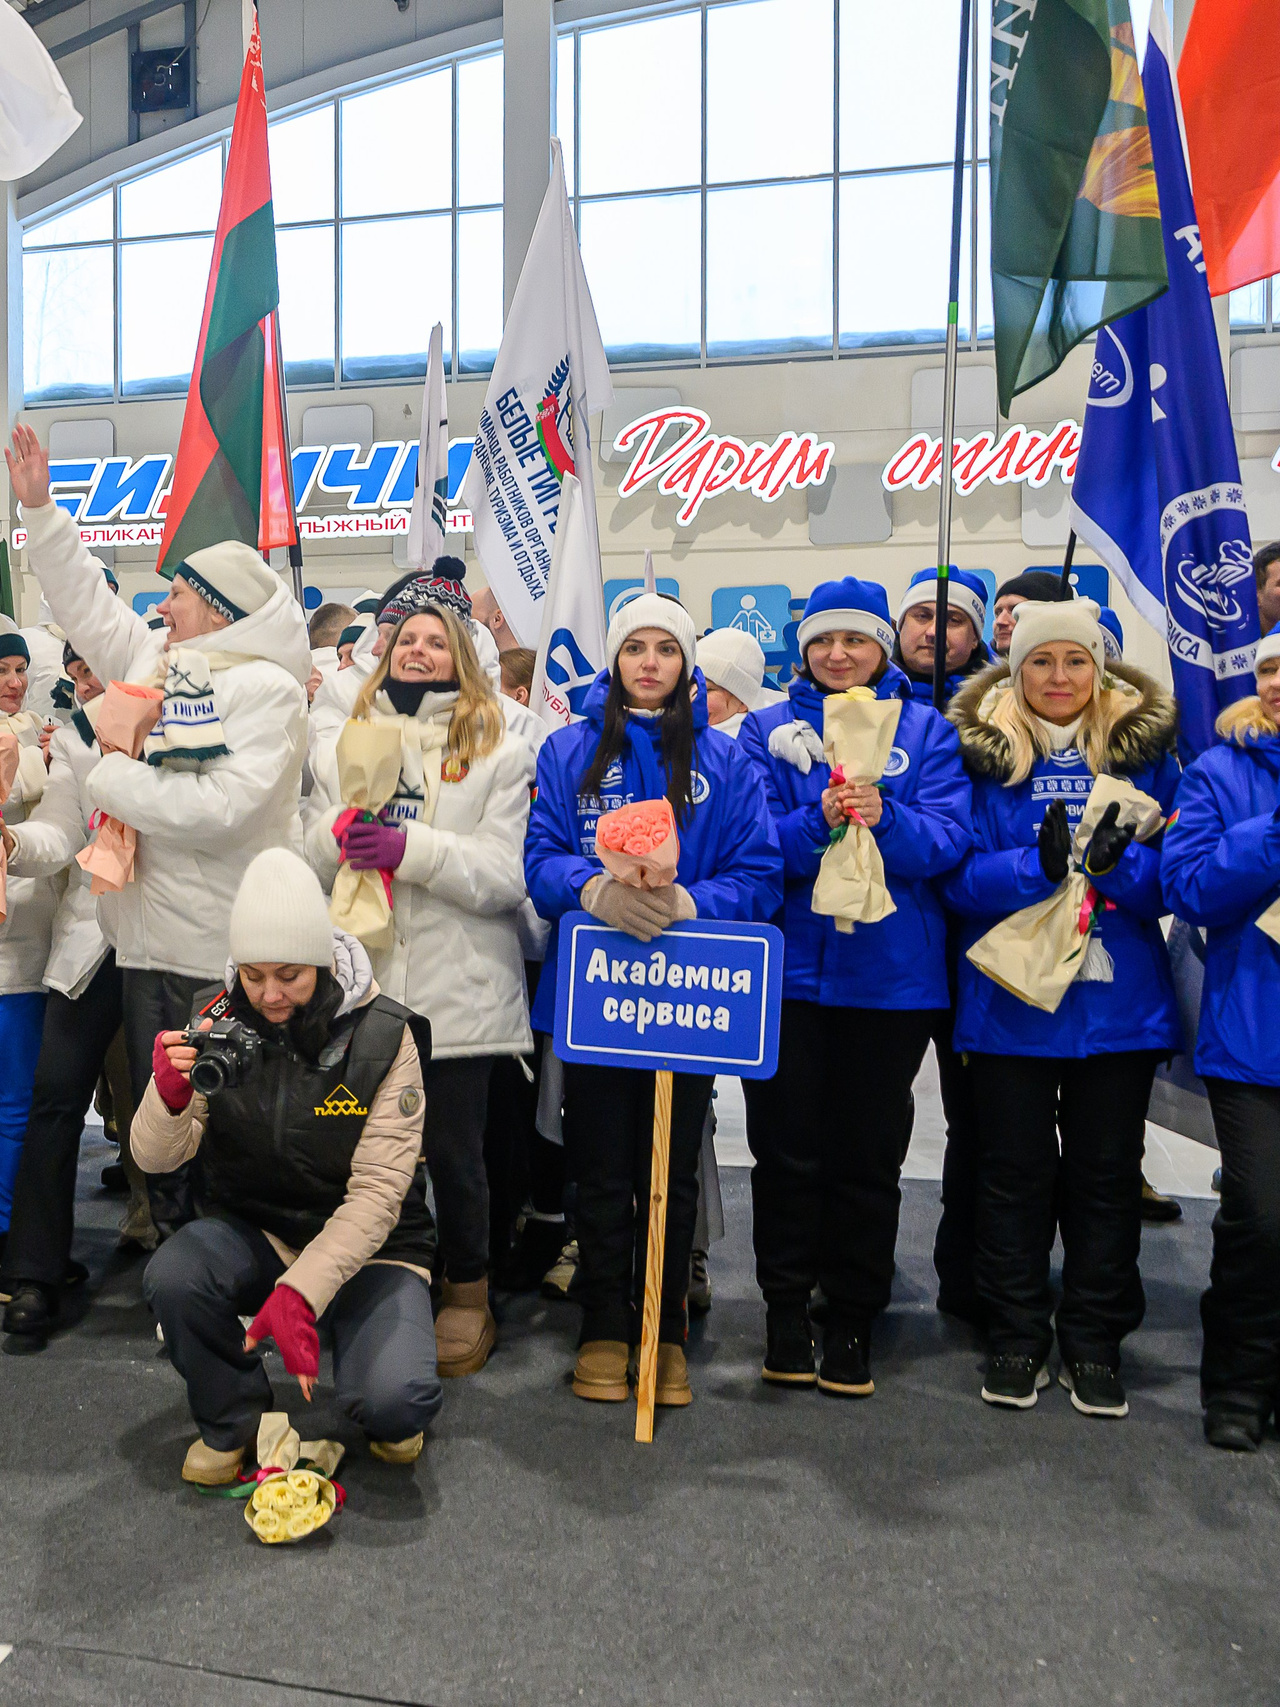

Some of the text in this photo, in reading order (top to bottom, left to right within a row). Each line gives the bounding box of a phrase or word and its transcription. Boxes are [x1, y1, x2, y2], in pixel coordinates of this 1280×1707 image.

[496, 386, 546, 469] БЕЛЫЕ
[480, 407, 502, 460] ОМАНДА
[494, 455, 534, 529] РАБОТНИКОВ
[619, 411, 830, 521] Дарим
[488, 486, 519, 542] ТУРИЗМА
[508, 539, 524, 552] И
[514, 550, 546, 601] ОТДЫХА
[585, 947, 752, 995] Академия
[603, 996, 731, 1035] сервиса
